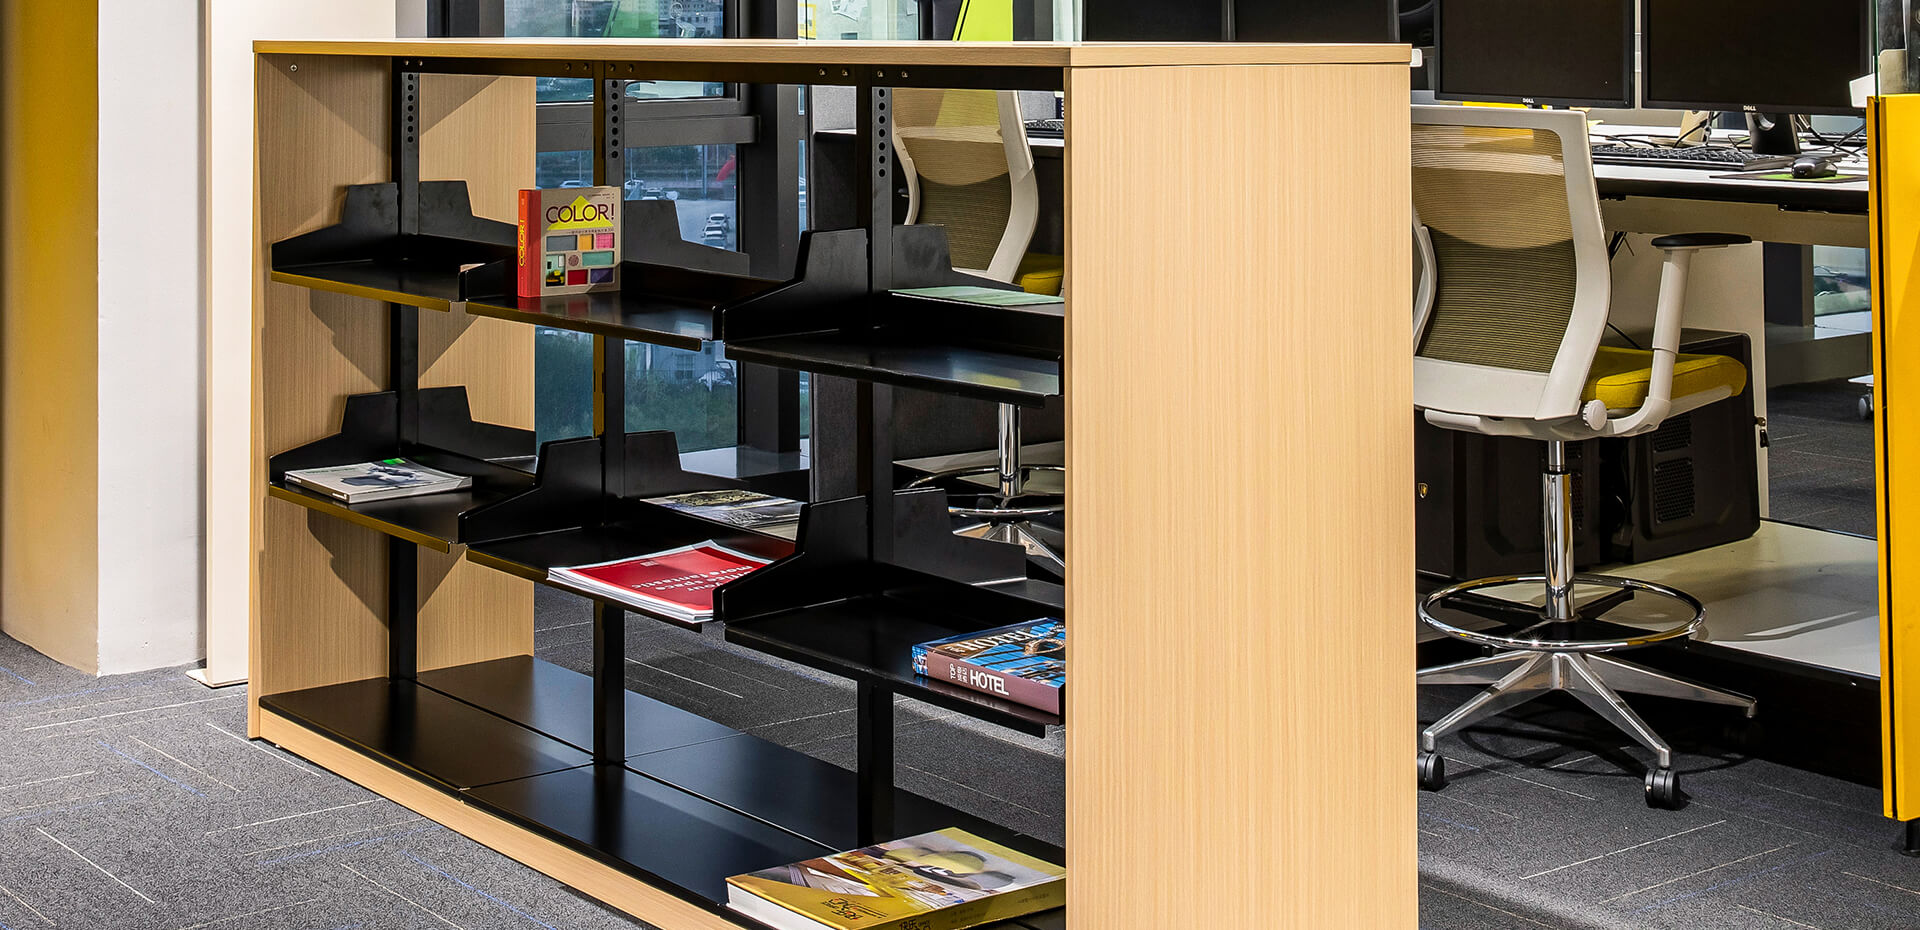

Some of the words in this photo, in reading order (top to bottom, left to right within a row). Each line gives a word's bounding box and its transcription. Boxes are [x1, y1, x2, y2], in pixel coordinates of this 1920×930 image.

[545, 203, 615, 224] COLOR!
[518, 219, 526, 267] COLOR!
[956, 630, 1042, 651] HOTEL
[969, 669, 1010, 696] HOTEL
